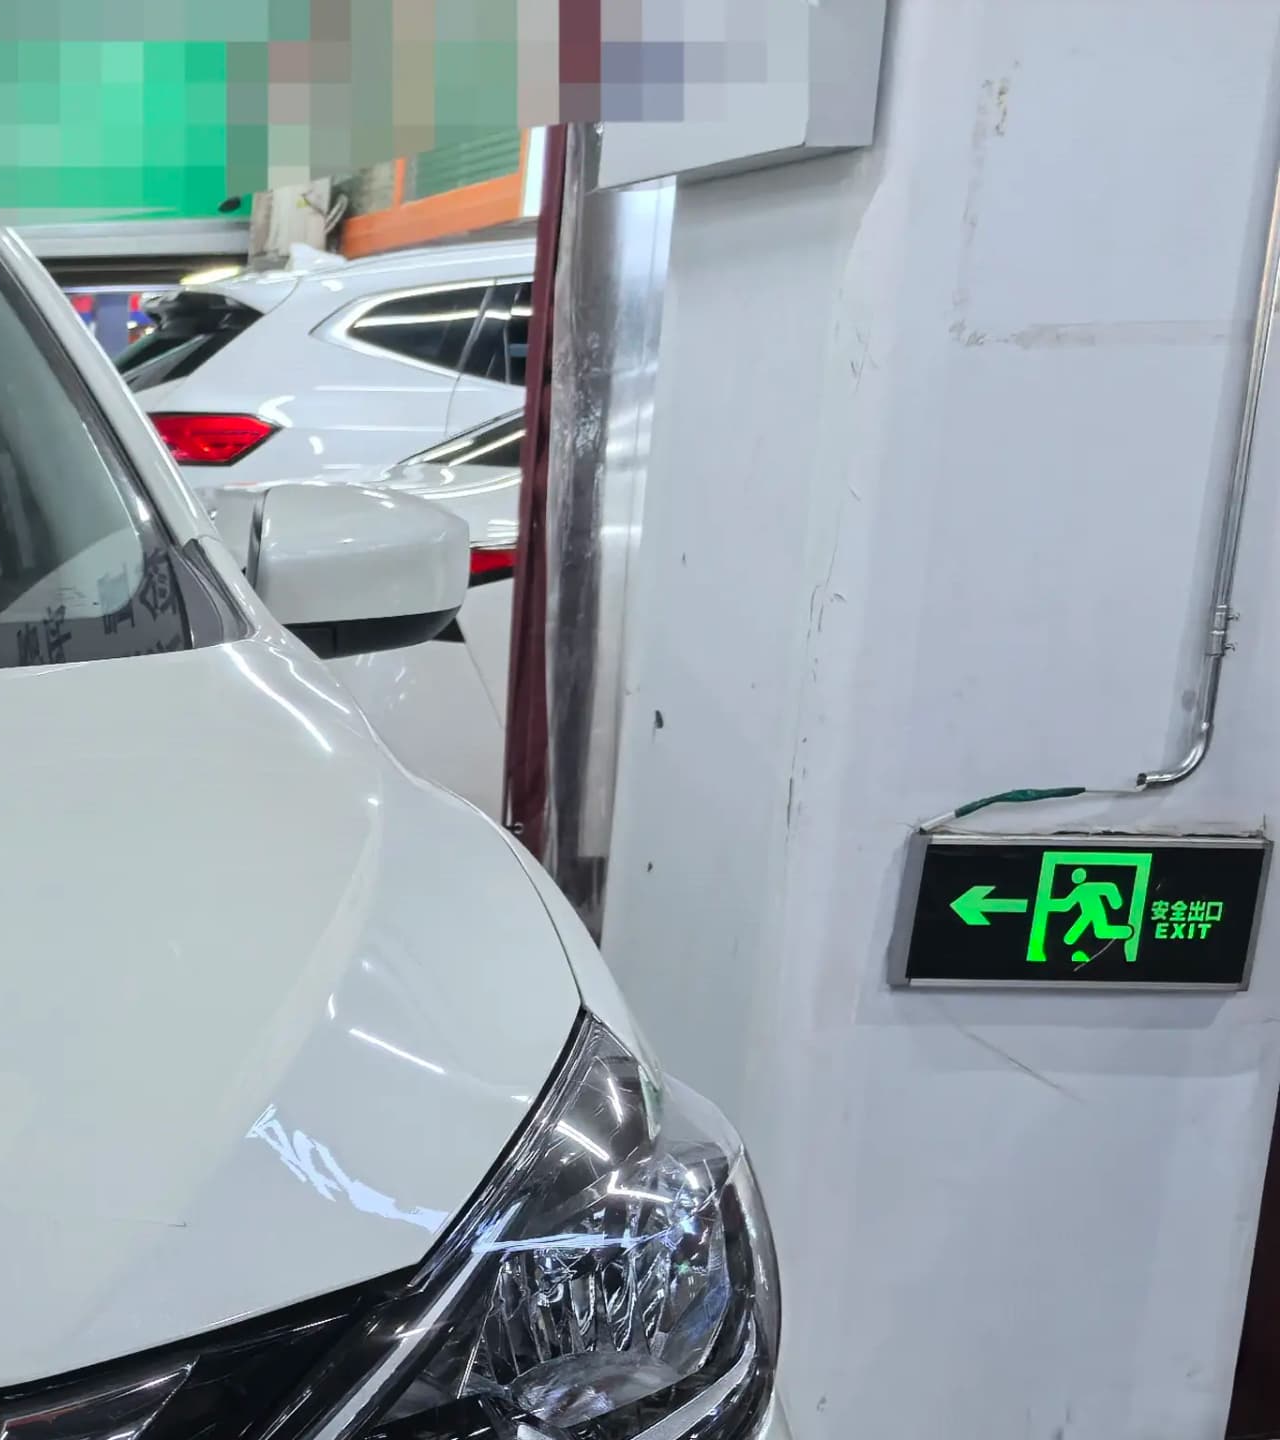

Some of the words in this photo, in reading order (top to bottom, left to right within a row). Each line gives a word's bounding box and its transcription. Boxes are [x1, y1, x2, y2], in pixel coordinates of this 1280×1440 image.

[1151, 900, 1223, 922] 安全出口
[1154, 922, 1212, 940] EXIT
